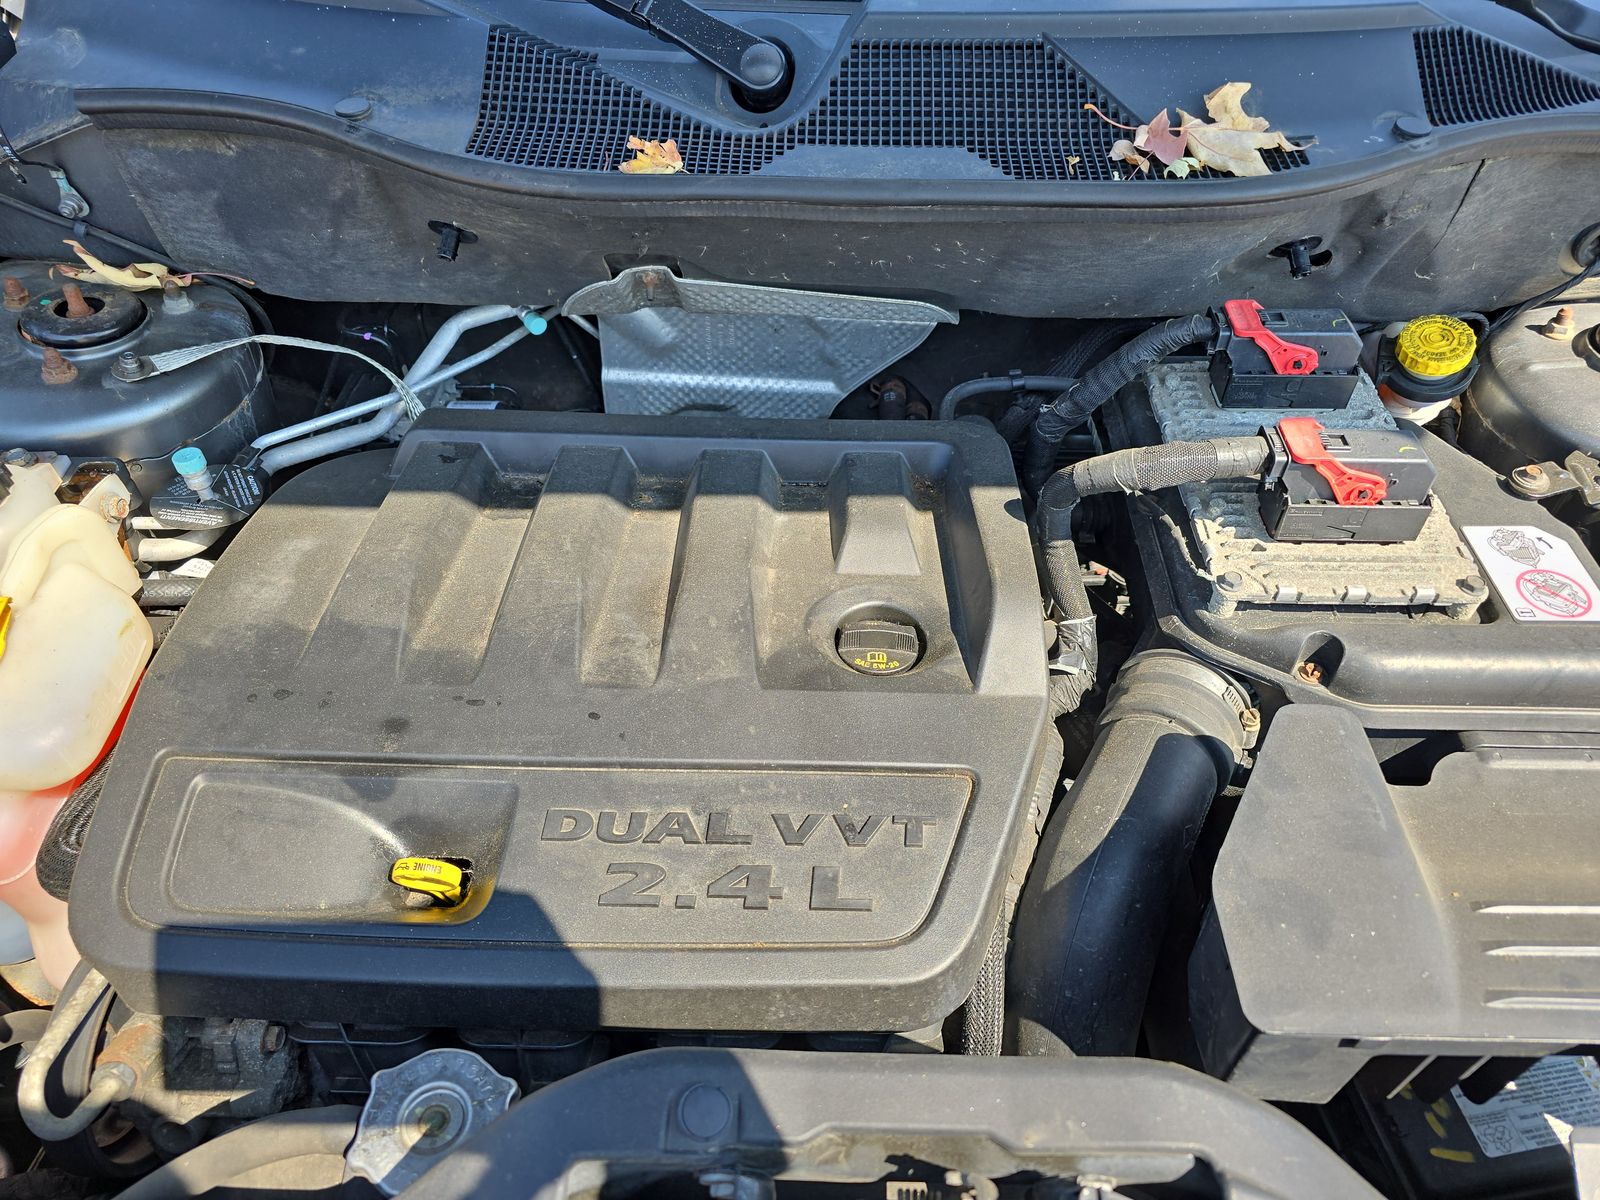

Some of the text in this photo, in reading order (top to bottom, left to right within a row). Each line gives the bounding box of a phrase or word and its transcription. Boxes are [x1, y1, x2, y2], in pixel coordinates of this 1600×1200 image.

[854, 658, 870, 668] SAE
[541, 808, 937, 848] DUAL VVT
[412, 862, 442, 875] ENGINE
[598, 861, 873, 912] 2.4 L
